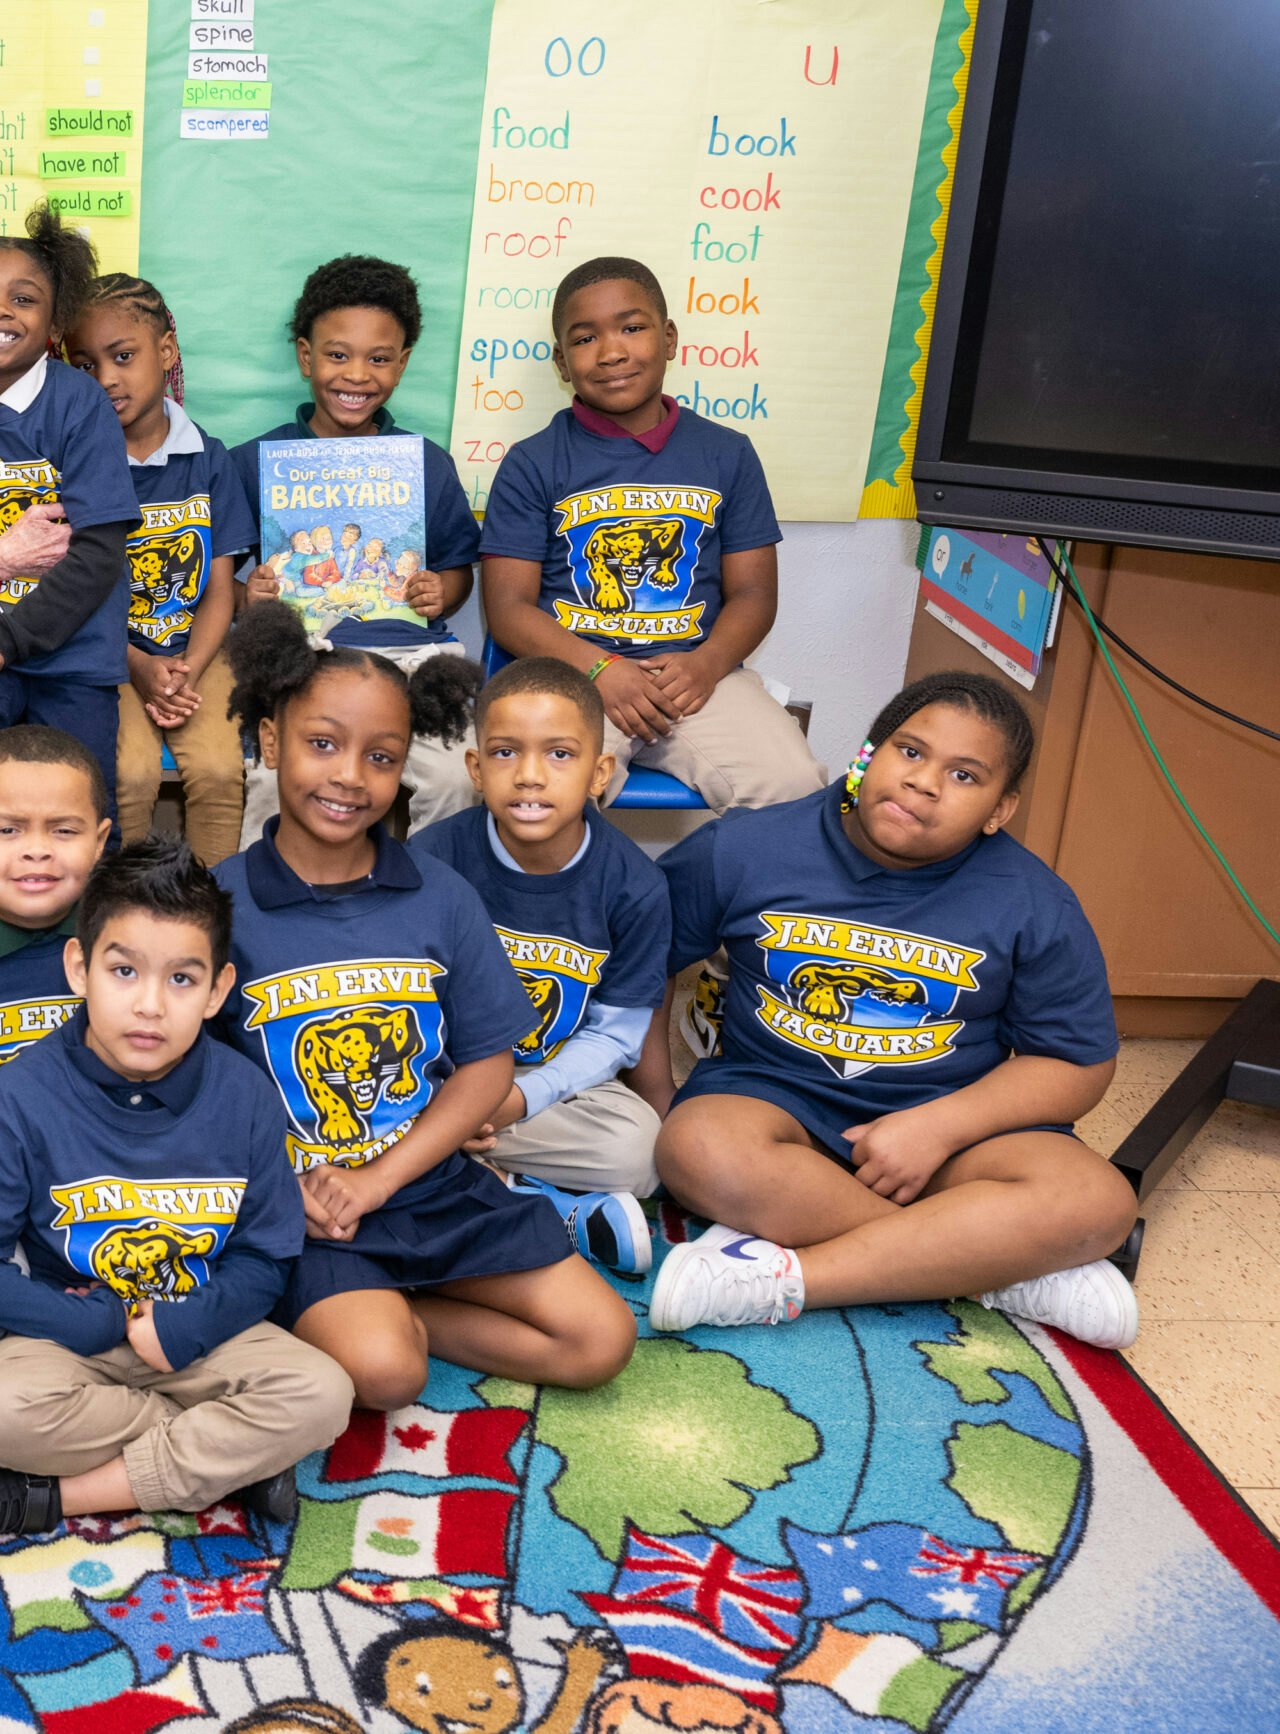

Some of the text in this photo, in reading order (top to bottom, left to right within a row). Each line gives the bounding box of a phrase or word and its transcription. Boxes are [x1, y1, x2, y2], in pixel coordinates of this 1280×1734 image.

[195, 26, 253, 45] spine
[193, 56, 266, 73] stomach
[49, 109, 132, 132] should not
[187, 113, 269, 136] scampered
[492, 107, 569, 149] food
[707, 115, 796, 156] book
[42, 152, 119, 173] have not
[51, 192, 123, 211] could not
[488, 163, 594, 208] broom
[700, 172, 781, 211] cook
[485, 217, 572, 258] roof
[690, 222, 764, 263] foot
[687, 276, 760, 314] look
[470, 338, 555, 378] spoo
[681, 330, 759, 368] rook
[472, 375, 524, 411] too
[267, 450, 293, 458] LAURA
[289, 466, 391, 481] Our Great Big
[272, 481, 411, 510] BACKYARD
[570, 490, 711, 526] J.N. ERVIN
[144, 500, 210, 529] ERVIN
[567, 610, 692, 636] JAGUARS
[775, 920, 965, 977] J.N. ERVIN
[264, 974, 329, 1019] J.N.
[771, 1004, 936, 1056] JAGUARS
[69, 1184, 245, 1222] J.N. ERVIN
